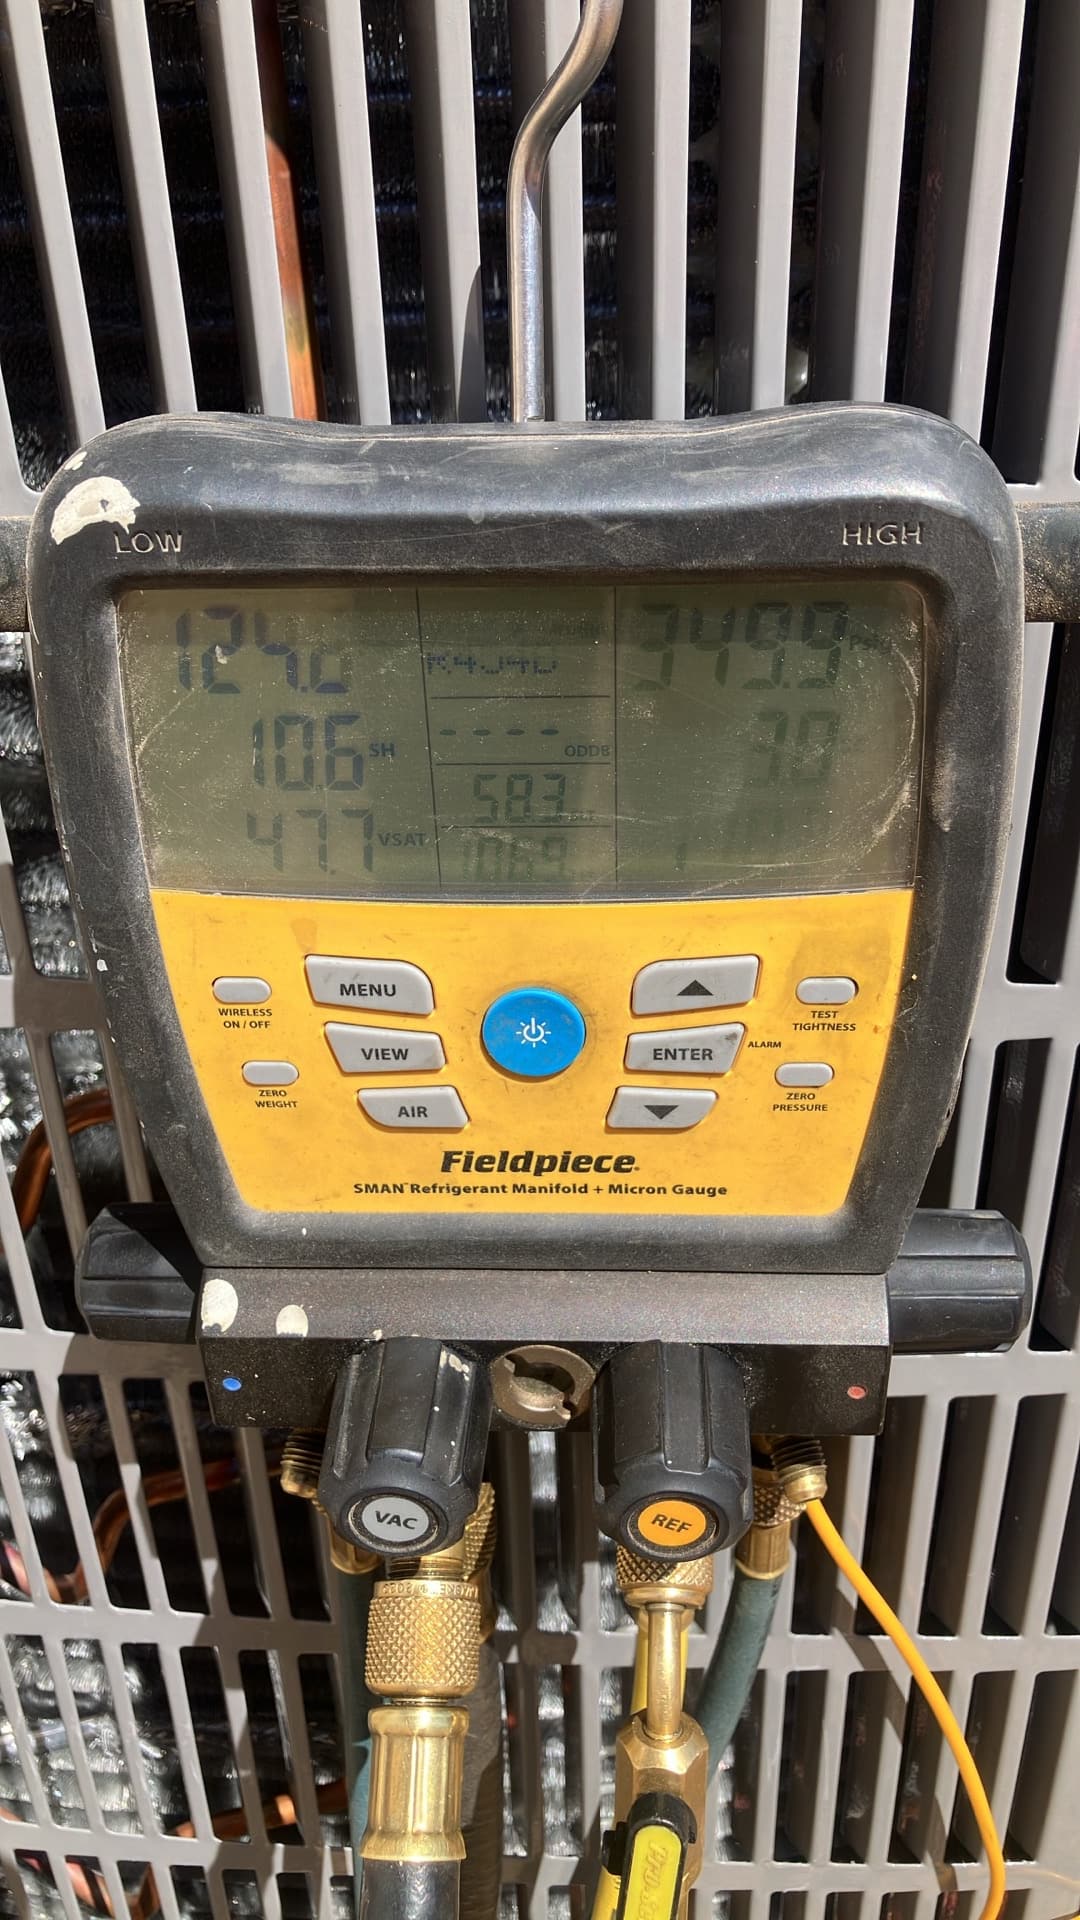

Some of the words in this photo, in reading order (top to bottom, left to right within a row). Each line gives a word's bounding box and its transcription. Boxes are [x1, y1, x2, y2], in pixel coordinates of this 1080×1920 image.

[842, 522, 924, 546] HIGH
[114, 530, 184, 554] LOW
[369, 742, 396, 758] SH
[377, 832, 427, 848] VSAT
[339, 983, 397, 998] MENU
[218, 1008, 273, 1018] WIRELESS
[811, 1010, 838, 1019] TEST
[223, 1020, 241, 1029] ON
[249, 1021, 271, 1029] OFF
[792, 1022, 857, 1032] TIGHTNESS
[748, 1041, 782, 1049] ALARM
[361, 1047, 409, 1061] VIEW
[653, 1048, 713, 1061] ENTER
[259, 1089, 287, 1098] ZERO
[786, 1092, 816, 1101] ZERO
[255, 1100, 299, 1109] WEIGHT
[772, 1103, 828, 1112] PRESSURE
[397, 1106, 428, 1118] AIR
[440, 1150, 637, 1177] Fieldpiece
[410, 1182, 508, 1196] Refrigerant
[511, 1183, 588, 1195] Manifold
[608, 1183, 668, 1195] Micron
[671, 1184, 728, 1197] Gauge
[375, 1510, 418, 1530] VAC
[651, 1513, 691, 1535] REF
